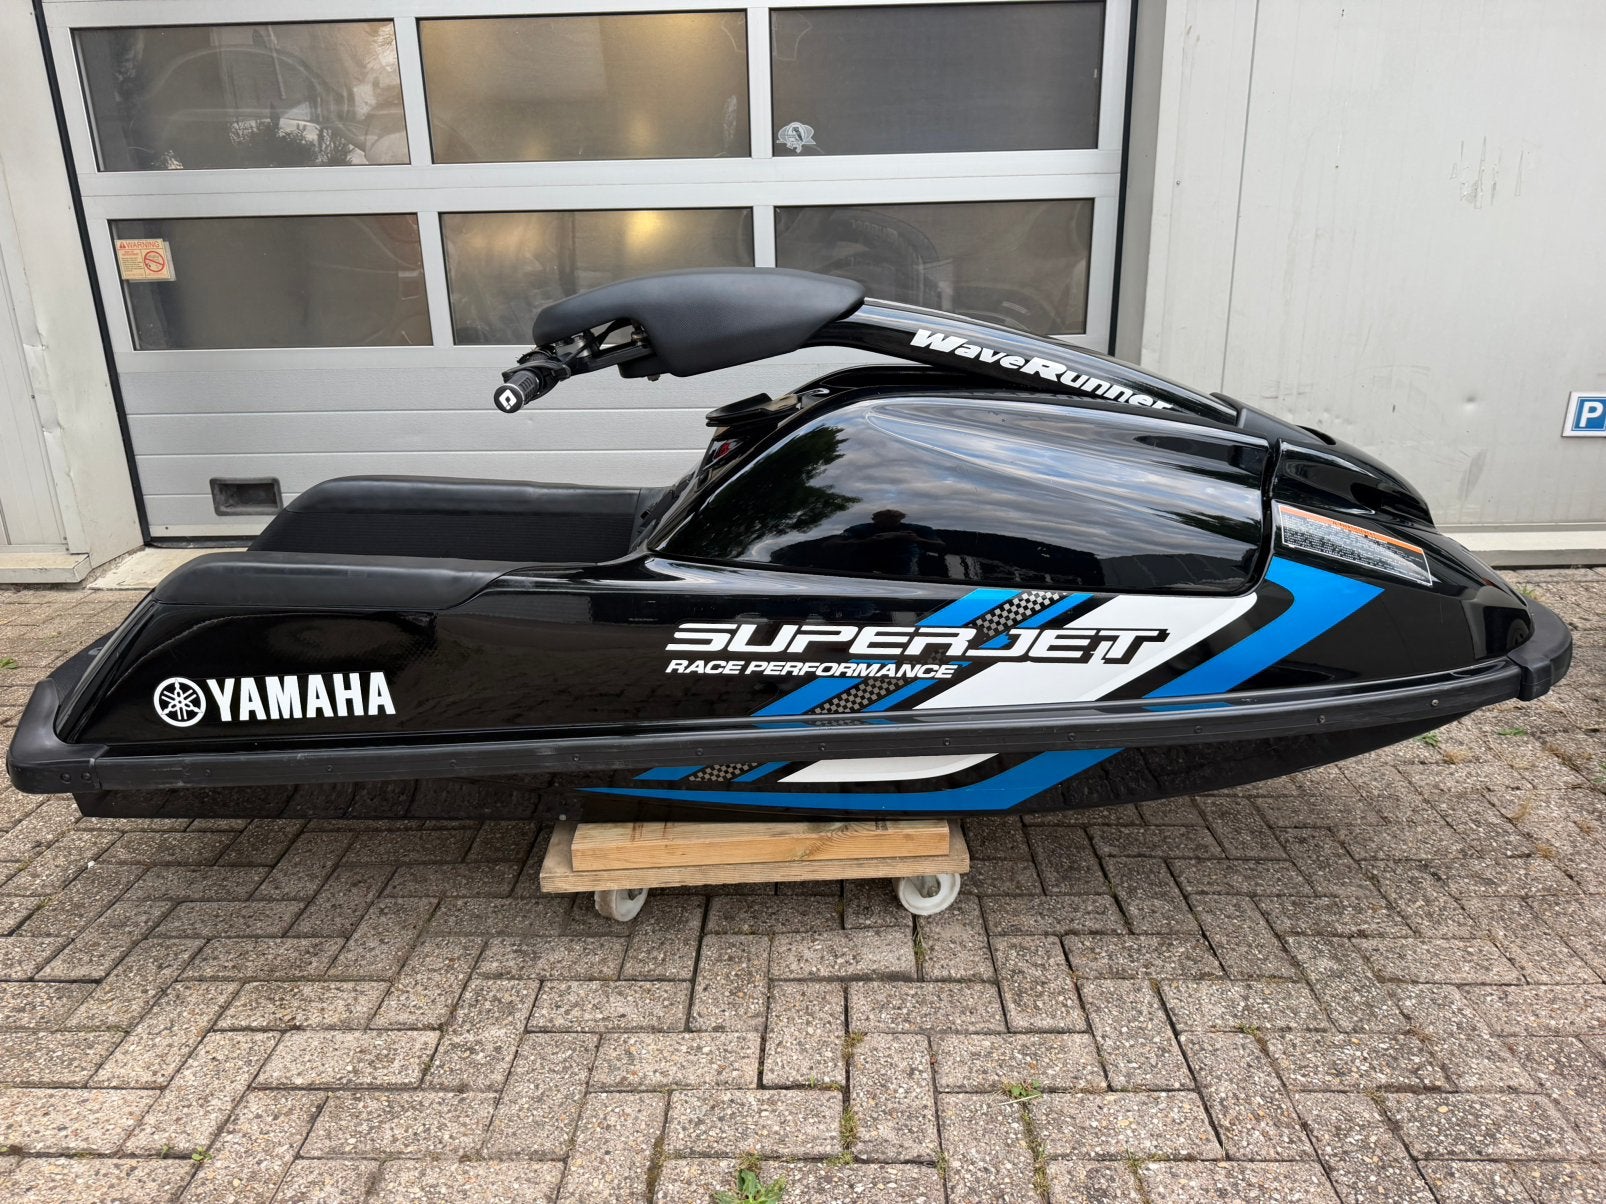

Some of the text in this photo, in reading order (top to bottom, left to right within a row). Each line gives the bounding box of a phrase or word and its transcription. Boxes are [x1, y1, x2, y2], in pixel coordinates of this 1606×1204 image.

[1579, 401, 1604, 428] P
[665, 623, 1166, 664] SUPERJET
[665, 659, 958, 679] RACE PERFORMANCE
[206, 671, 396, 722] YAMAHA
